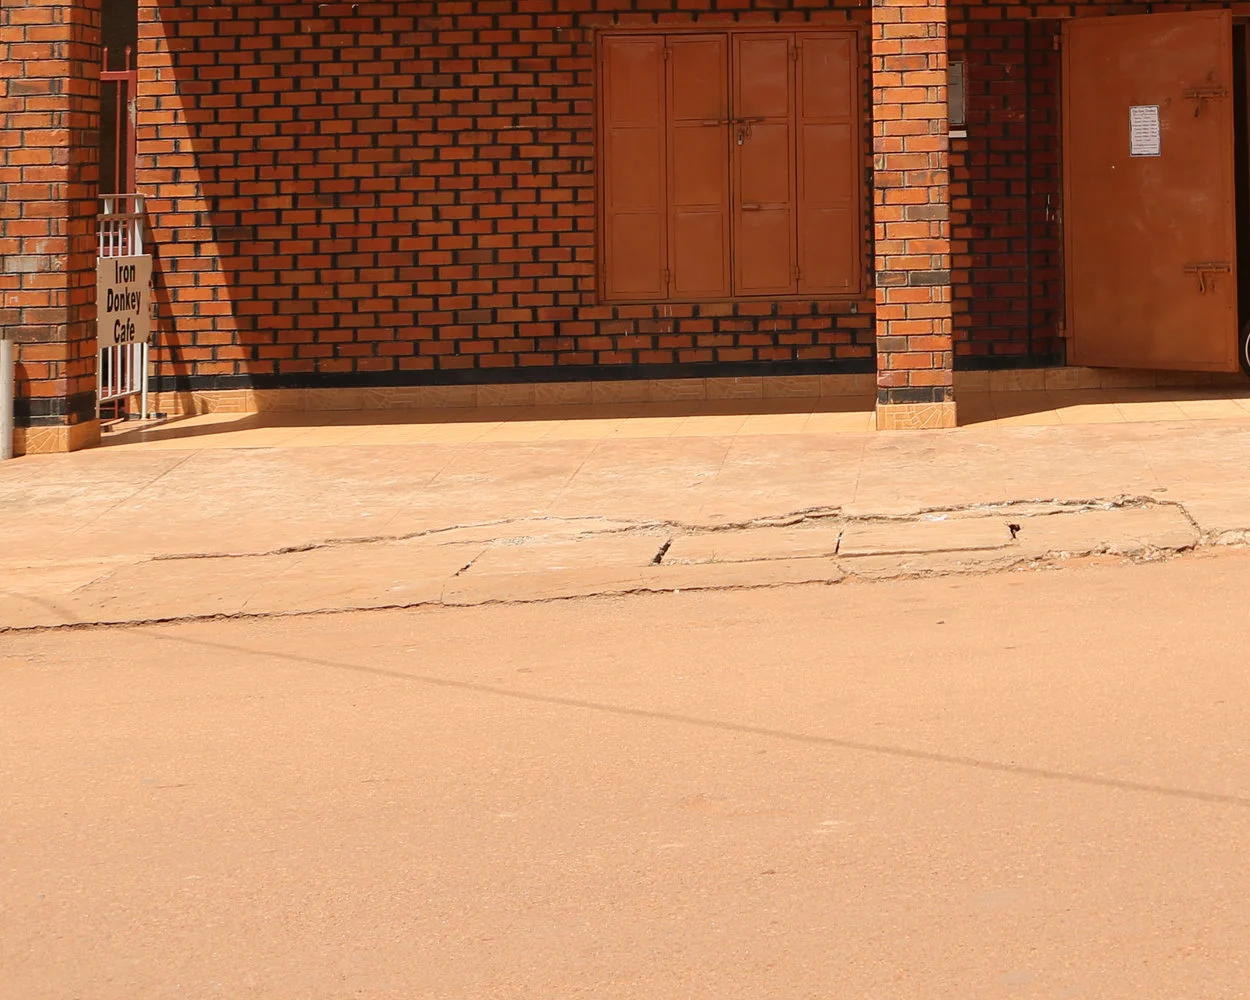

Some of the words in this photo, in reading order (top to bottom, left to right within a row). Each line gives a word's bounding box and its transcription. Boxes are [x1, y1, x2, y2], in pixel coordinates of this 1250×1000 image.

[115, 260, 136, 285] Iron
[106, 287, 142, 315] Donkey
[113, 317, 136, 343] Cafe
